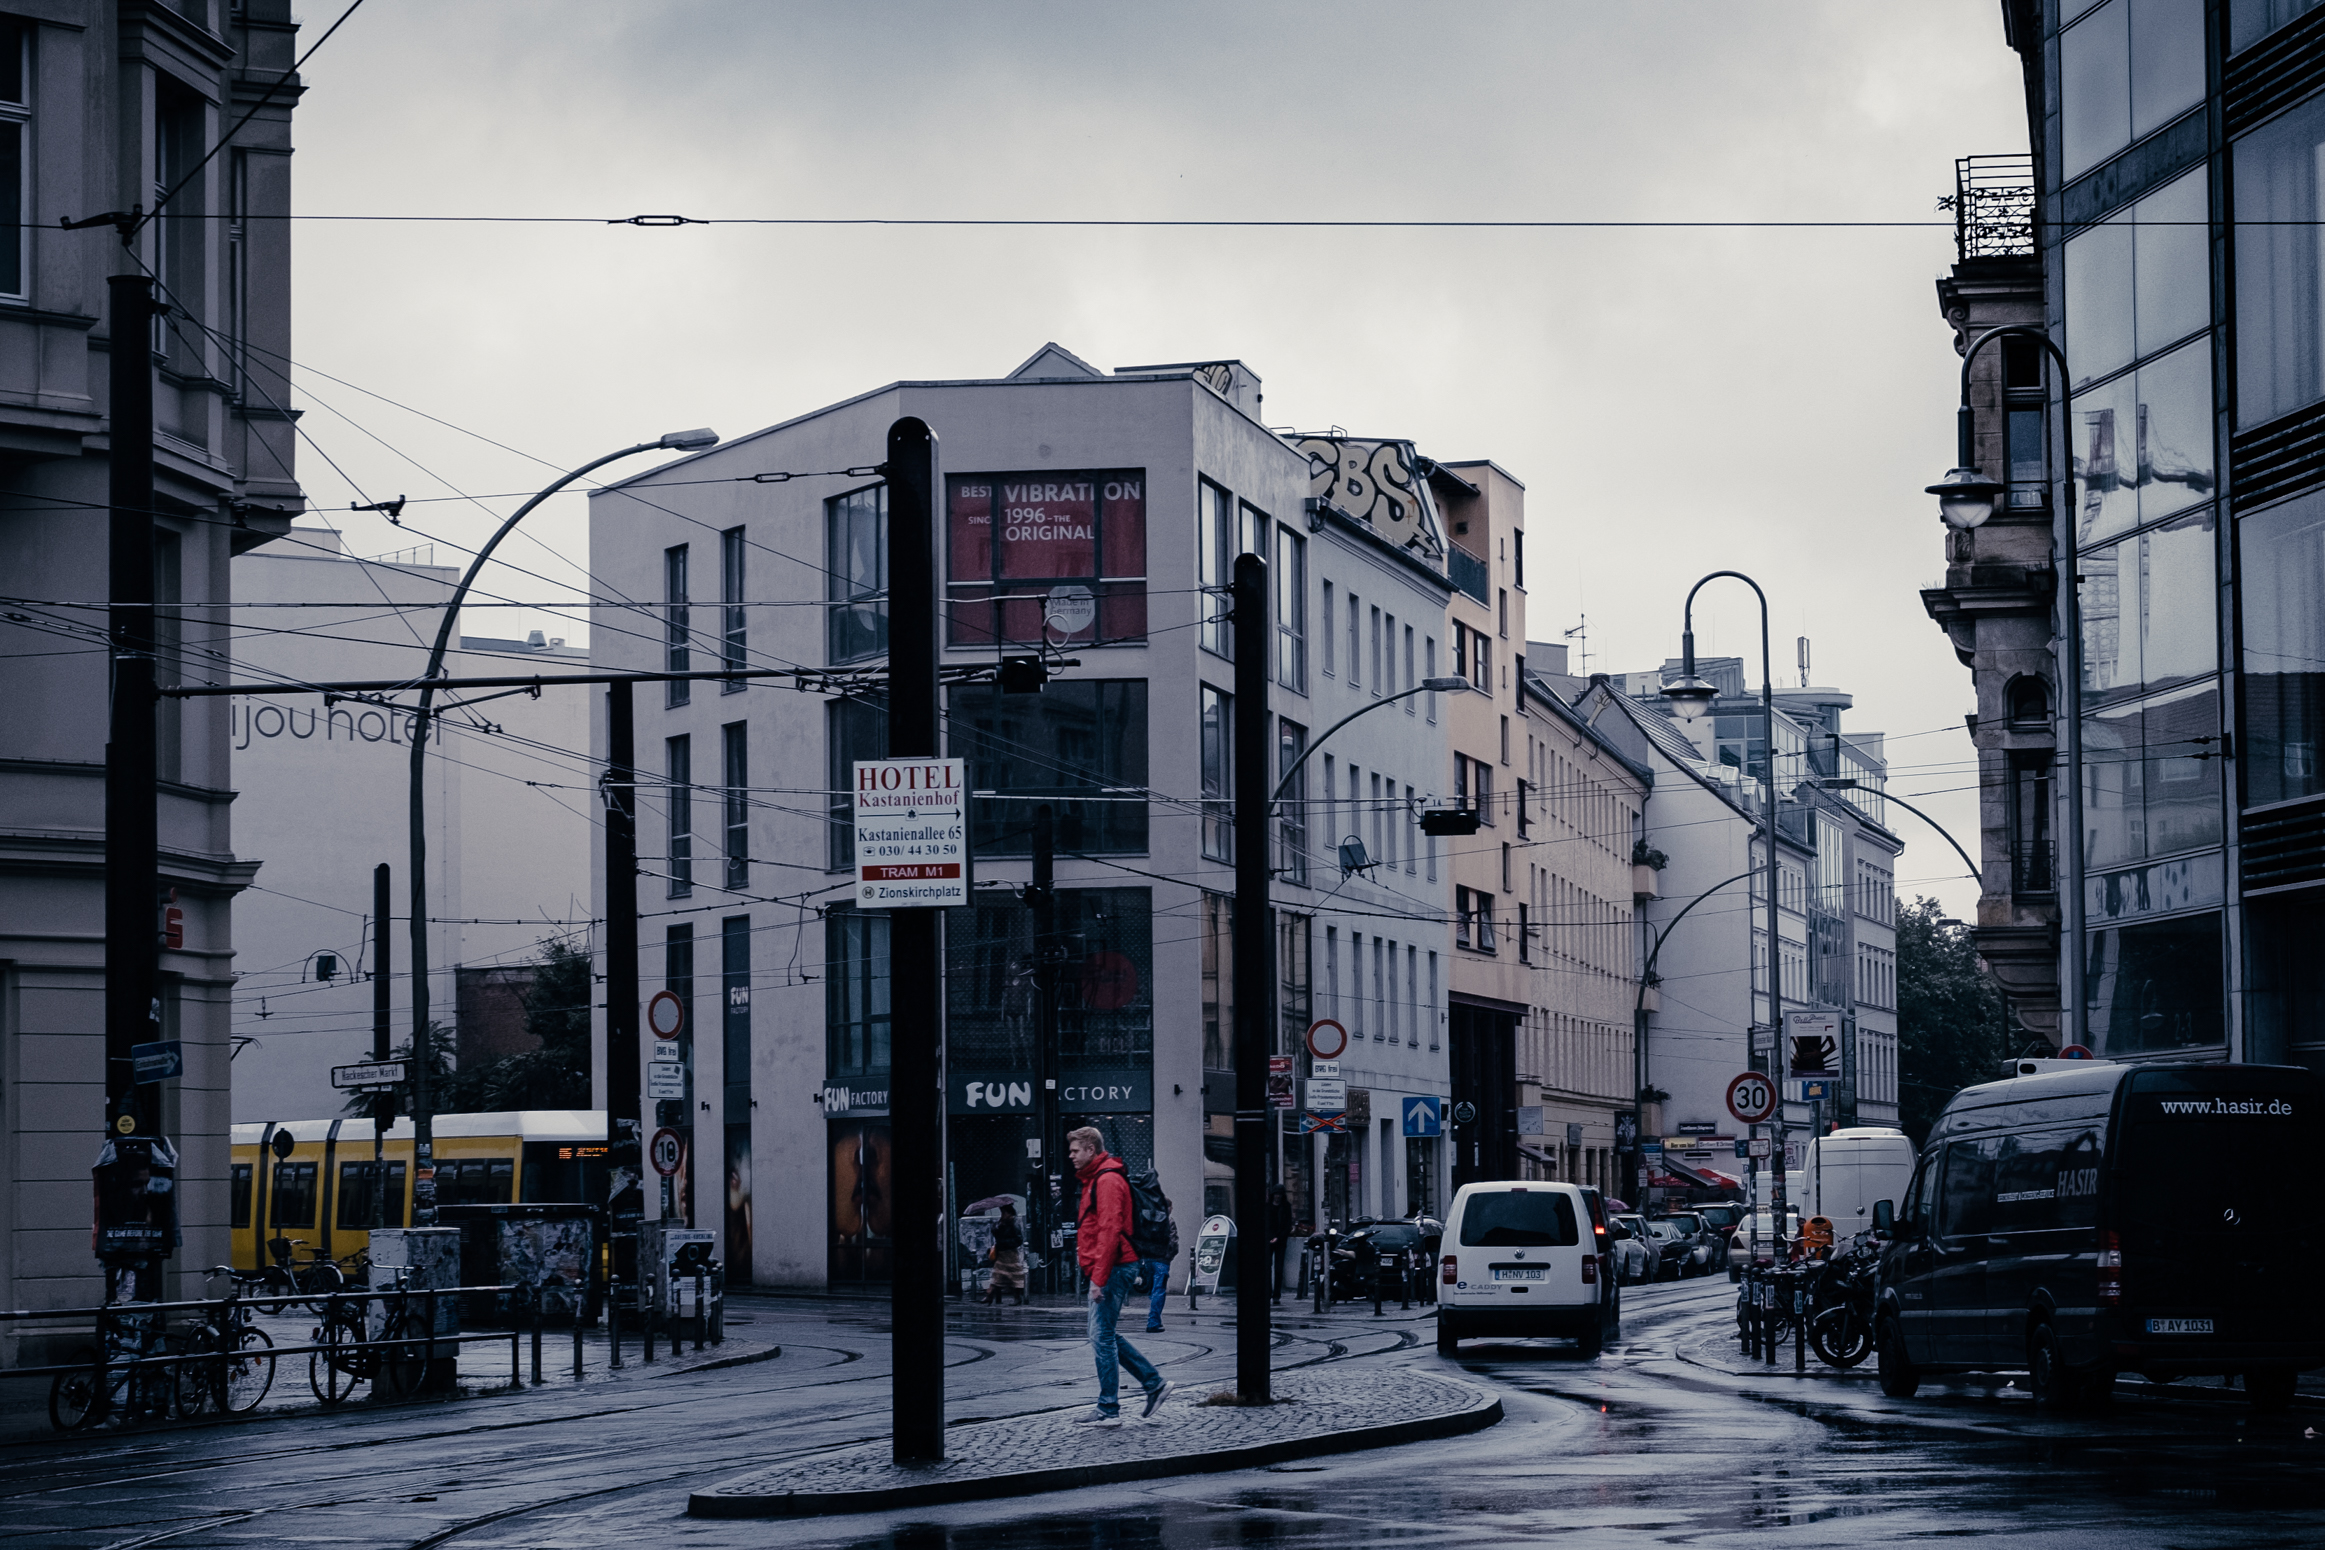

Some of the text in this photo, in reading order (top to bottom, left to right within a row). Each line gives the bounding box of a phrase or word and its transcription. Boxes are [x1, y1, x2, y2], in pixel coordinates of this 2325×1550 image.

[1004, 481, 1141, 502] VIBRATION
[968, 516, 992, 525] SINC
[1005, 507, 1045, 524] 1996
[1005, 525, 1095, 541] ORIGINAL
[1051, 606, 1092, 616] Germany
[231, 696, 315, 750] ijou
[857, 765, 961, 791] HOTEL
[858, 790, 960, 807] Kastanienhof
[858, 825, 962, 842] Kastanienallee 65
[879, 844, 957, 856] 030/ 44 30 50
[880, 866, 943, 878] TRAM M1
[879, 886, 961, 899] Zionskirchplatz
[731, 986, 749, 1005] FUN
[341, 1067, 398, 1080] Hackescher Markt
[824, 1086, 888, 1112] FUN FACTORY
[966, 1081, 1133, 1108] FUN CTORY
[1737, 1086, 1766, 1109] 30
[2160, 1097, 2293, 1115] www.hasir.de
[659, 1141, 676, 1163] 10
[2056, 1168, 2098, 1197] HASIR
[1526, 1270, 1541, 1279] 103
[2152, 1320, 2213, 1332] B AY 1031
